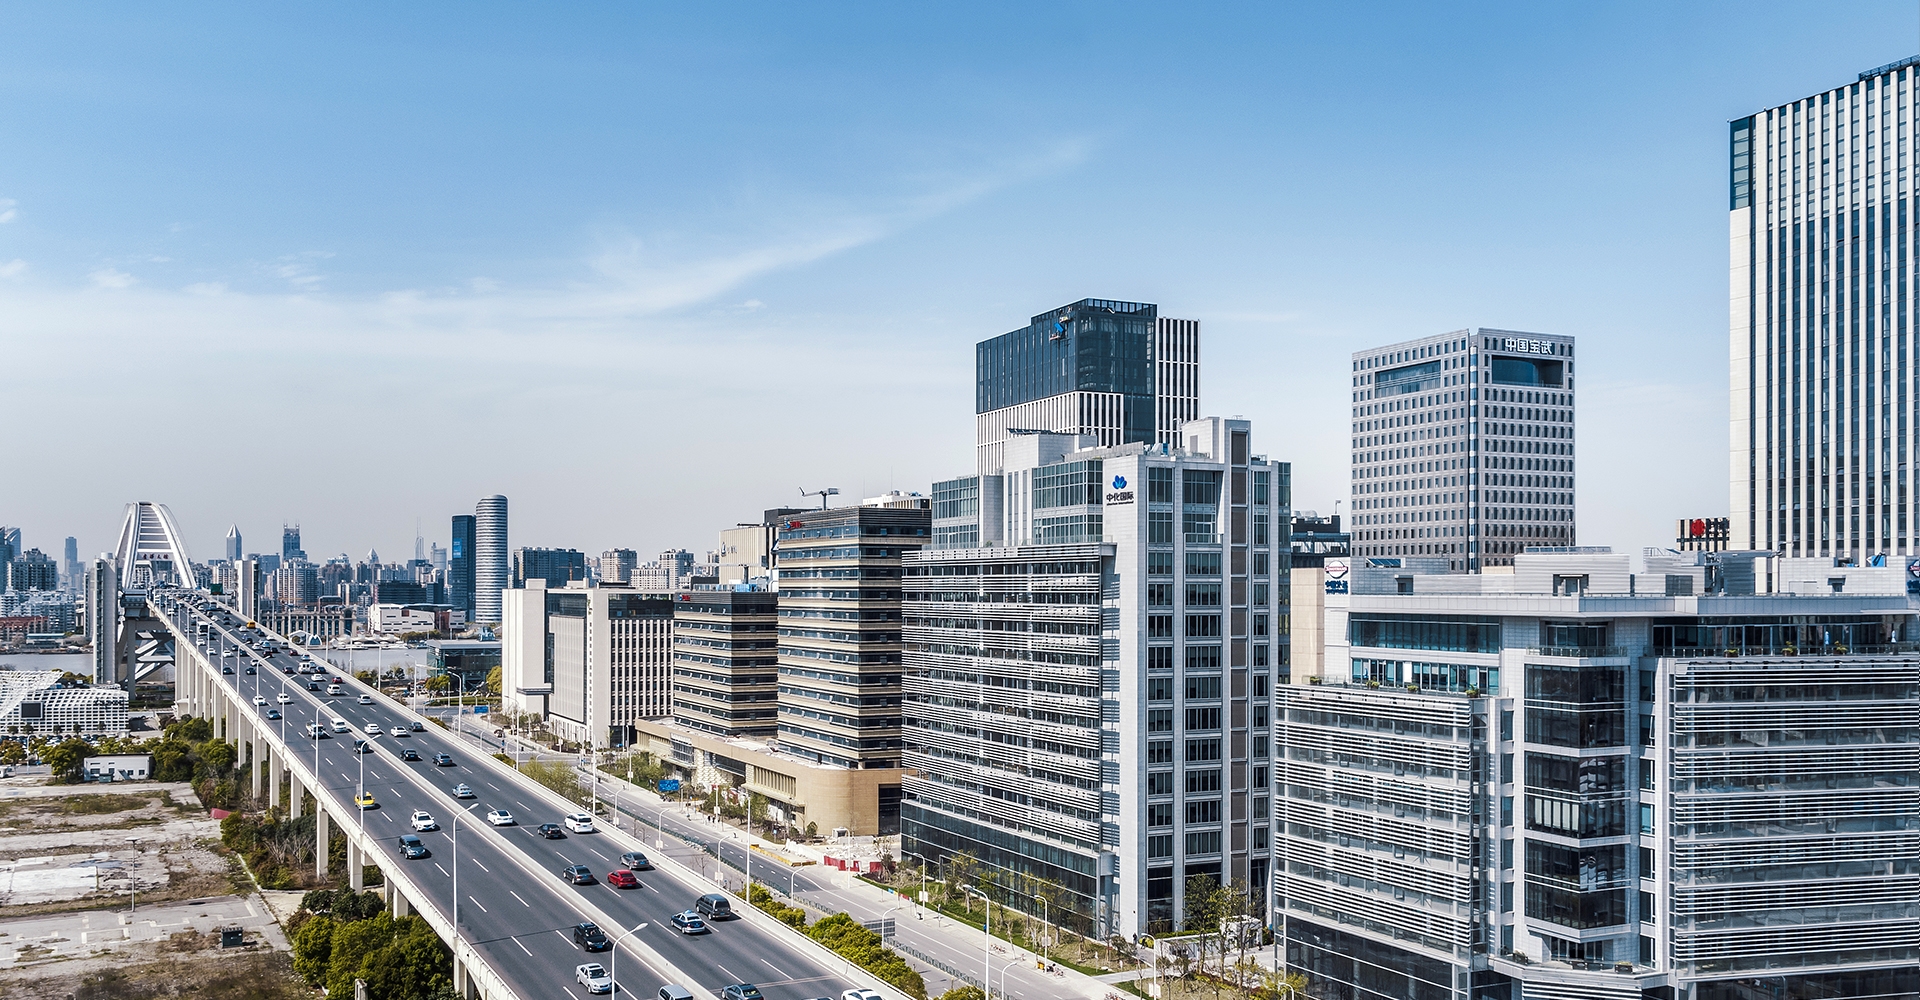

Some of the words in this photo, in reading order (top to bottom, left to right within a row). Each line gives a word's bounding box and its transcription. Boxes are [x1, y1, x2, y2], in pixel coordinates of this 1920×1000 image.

[1505, 337, 1553, 355] 中国宝武
[1106, 491, 1134, 502] 中化国际
